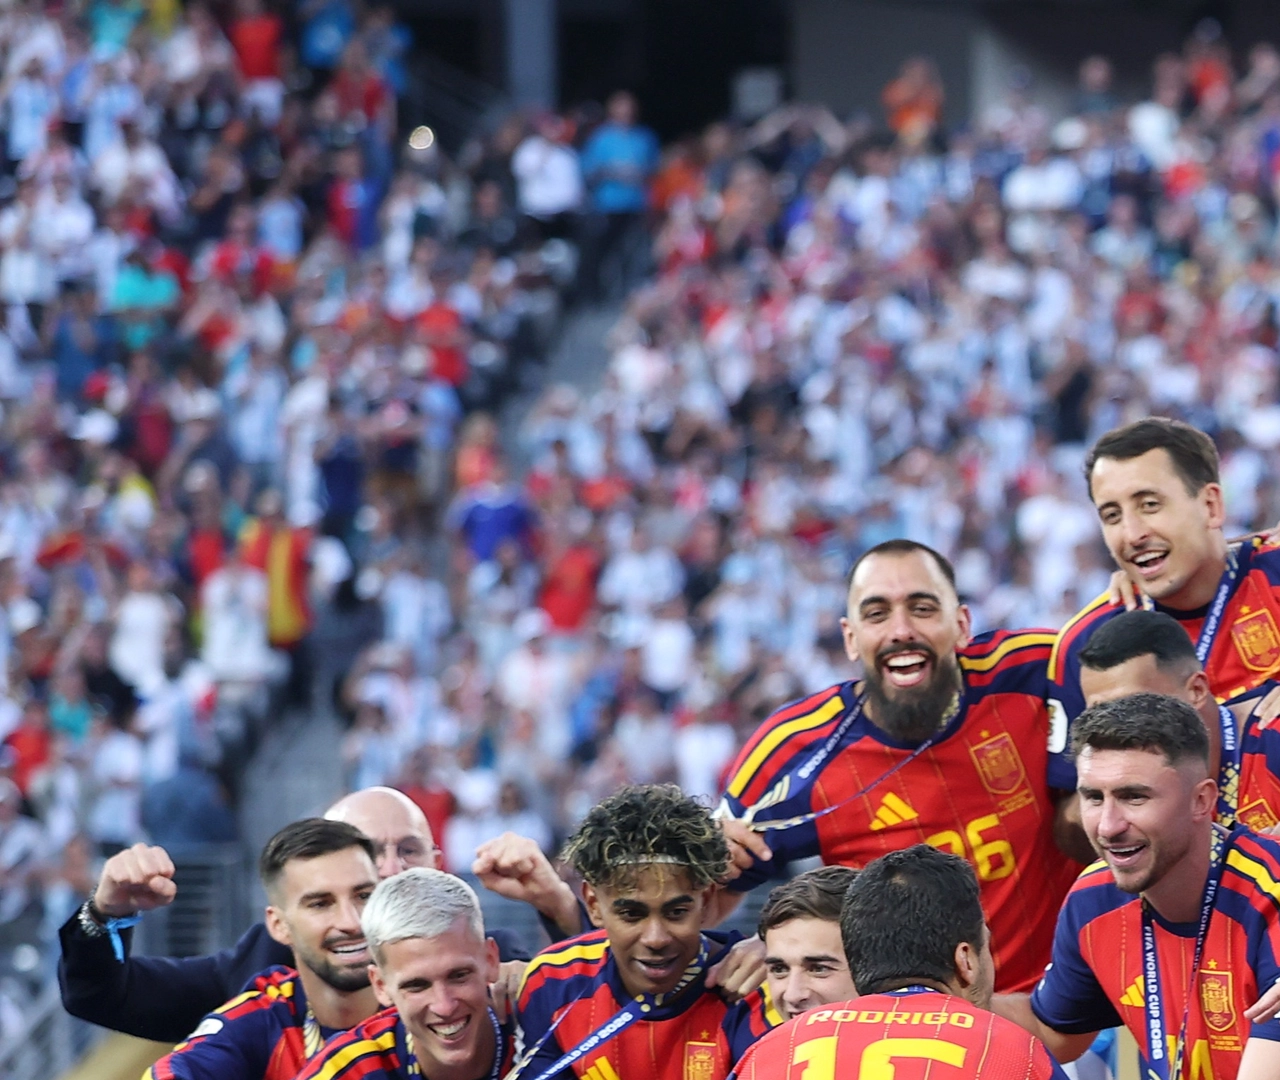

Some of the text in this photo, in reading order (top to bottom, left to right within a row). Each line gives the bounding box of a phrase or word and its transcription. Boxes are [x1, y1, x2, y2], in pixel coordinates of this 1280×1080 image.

[1213, 584, 1229, 617] 2026
[797, 748, 828, 779] 2026
[1205, 879, 1217, 907] FIFA
[1144, 926, 1163, 1060] FIFA WORLD CUP 2026
[806, 1009, 975, 1029] RODRIGO
[548, 1050, 582, 1075] WORLD
[581, 1036, 600, 1052] CUP
[598, 1011, 634, 1039] 2026
